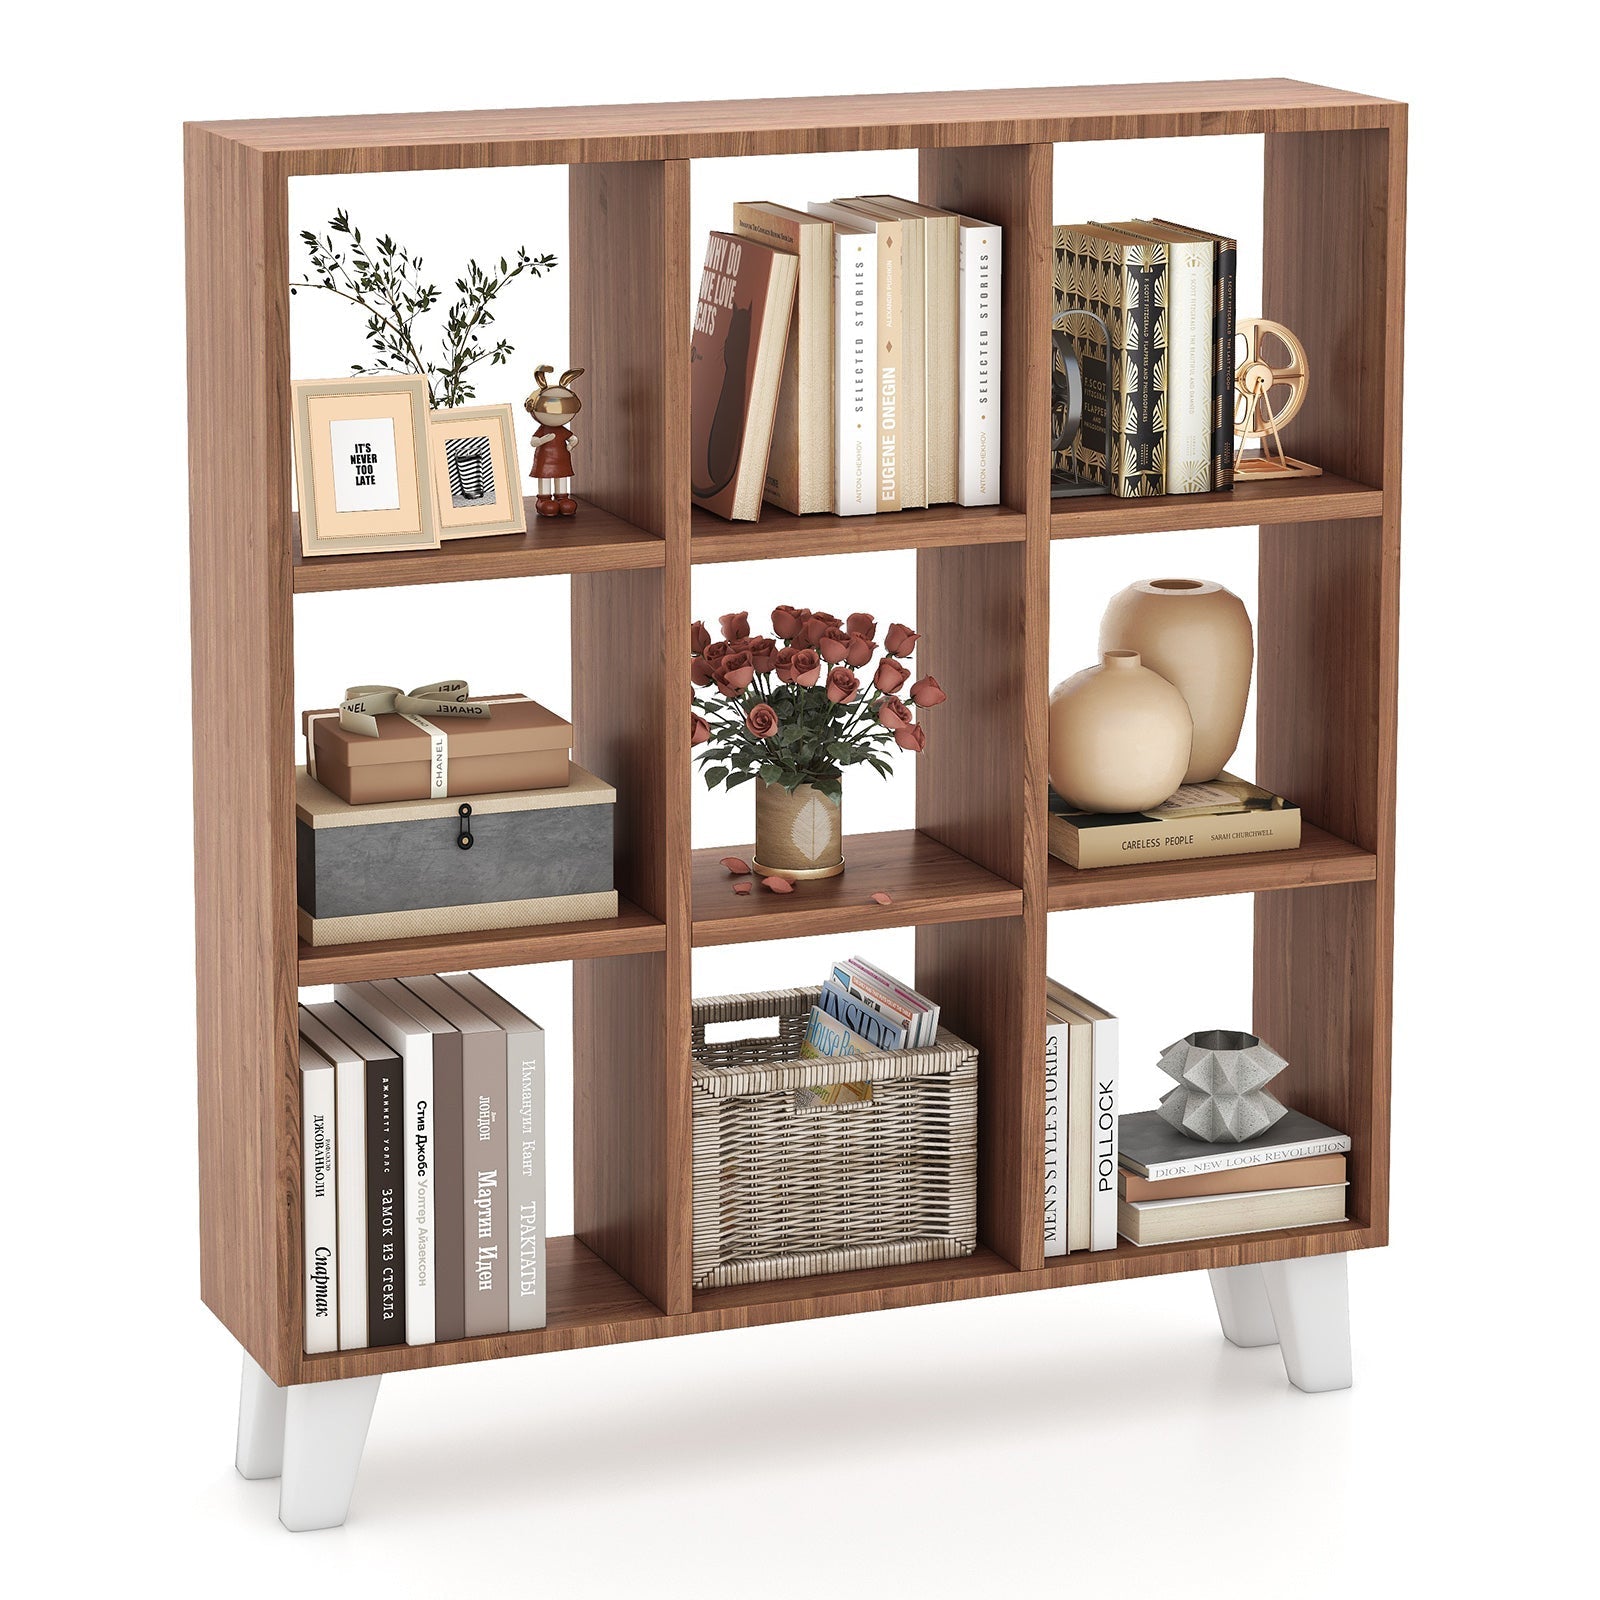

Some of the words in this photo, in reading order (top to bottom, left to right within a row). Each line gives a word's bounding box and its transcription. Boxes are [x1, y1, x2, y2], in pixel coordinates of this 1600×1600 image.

[704, 236, 728, 272] WHY
[727, 242, 742, 277] DO
[700, 270, 716, 301] WE
[713, 274, 737, 310] LOVE
[855, 261, 864, 327] STORIES
[979, 254, 989, 319] STORIES
[694, 301, 717, 336] CATS
[855, 338, 864, 412] SELECTED
[979, 330, 988, 403] SELECTED
[882, 367, 896, 430] ONEGIN
[350, 453, 377, 464] NEVER
[355, 443, 371, 454] IT'S
[356, 465, 374, 475] TOO
[882, 435, 896, 501] EUGENE
[355, 475, 376, 486] LATE
[1121, 838, 1161, 851] CARELESS
[1165, 834, 1194, 847] PEOPLE
[1210, 833, 1231, 842] SARAH
[1231, 829, 1274, 840] CHURCHWELL
[822, 986, 897, 1051] INSIDE
[417, 1100, 427, 1131] Стив
[520, 1059, 536, 1134] Иммануил
[313, 1115, 325, 1197] ДЖОВАНЬОЛИ
[415, 1134, 427, 1177] Джобс
[522, 1139, 536, 1176] Кант
[1098, 1080, 1114, 1192] POLLOCK
[1193, 1159, 1224, 1172] NEW
[1226, 1154, 1261, 1167] LOOK
[1265, 1141, 1347, 1161] REVOLUTION
[416, 1179, 428, 1224] Уолтер
[473, 1169, 498, 1239] Мартин
[382, 1243, 394, 1261] из
[418, 1227, 428, 1287] Айзексон
[475, 1245, 498, 1291] Иден
[520, 1200, 536, 1297] ТРАКТАТЫ
[310, 1246, 331, 1317] Спартак
[382, 1267, 394, 1320] стекла
